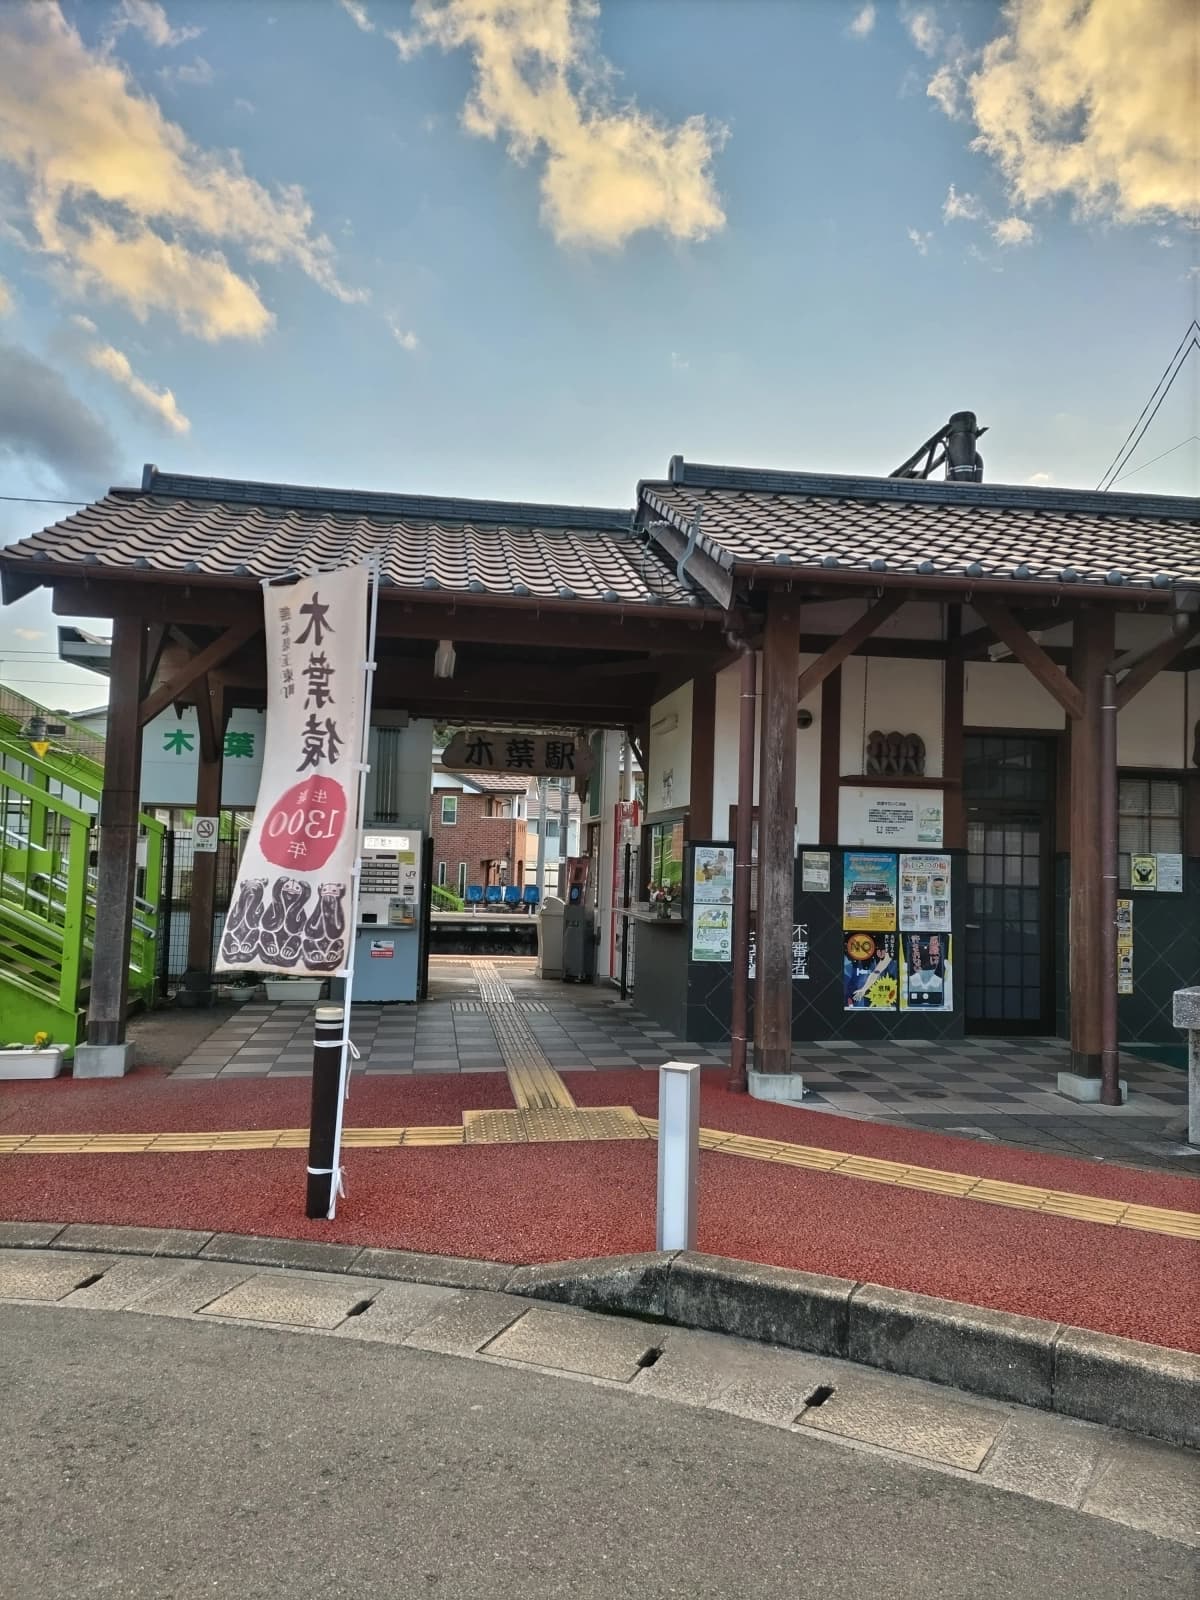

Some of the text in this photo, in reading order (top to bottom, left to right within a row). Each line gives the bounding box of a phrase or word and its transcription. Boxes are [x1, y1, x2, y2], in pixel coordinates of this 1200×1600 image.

[464, 737, 576, 770] 木葉駅
[405, 870, 416, 878] JR
[792, 923, 808, 977] 不審者
[851, 941, 871, 952] NO
